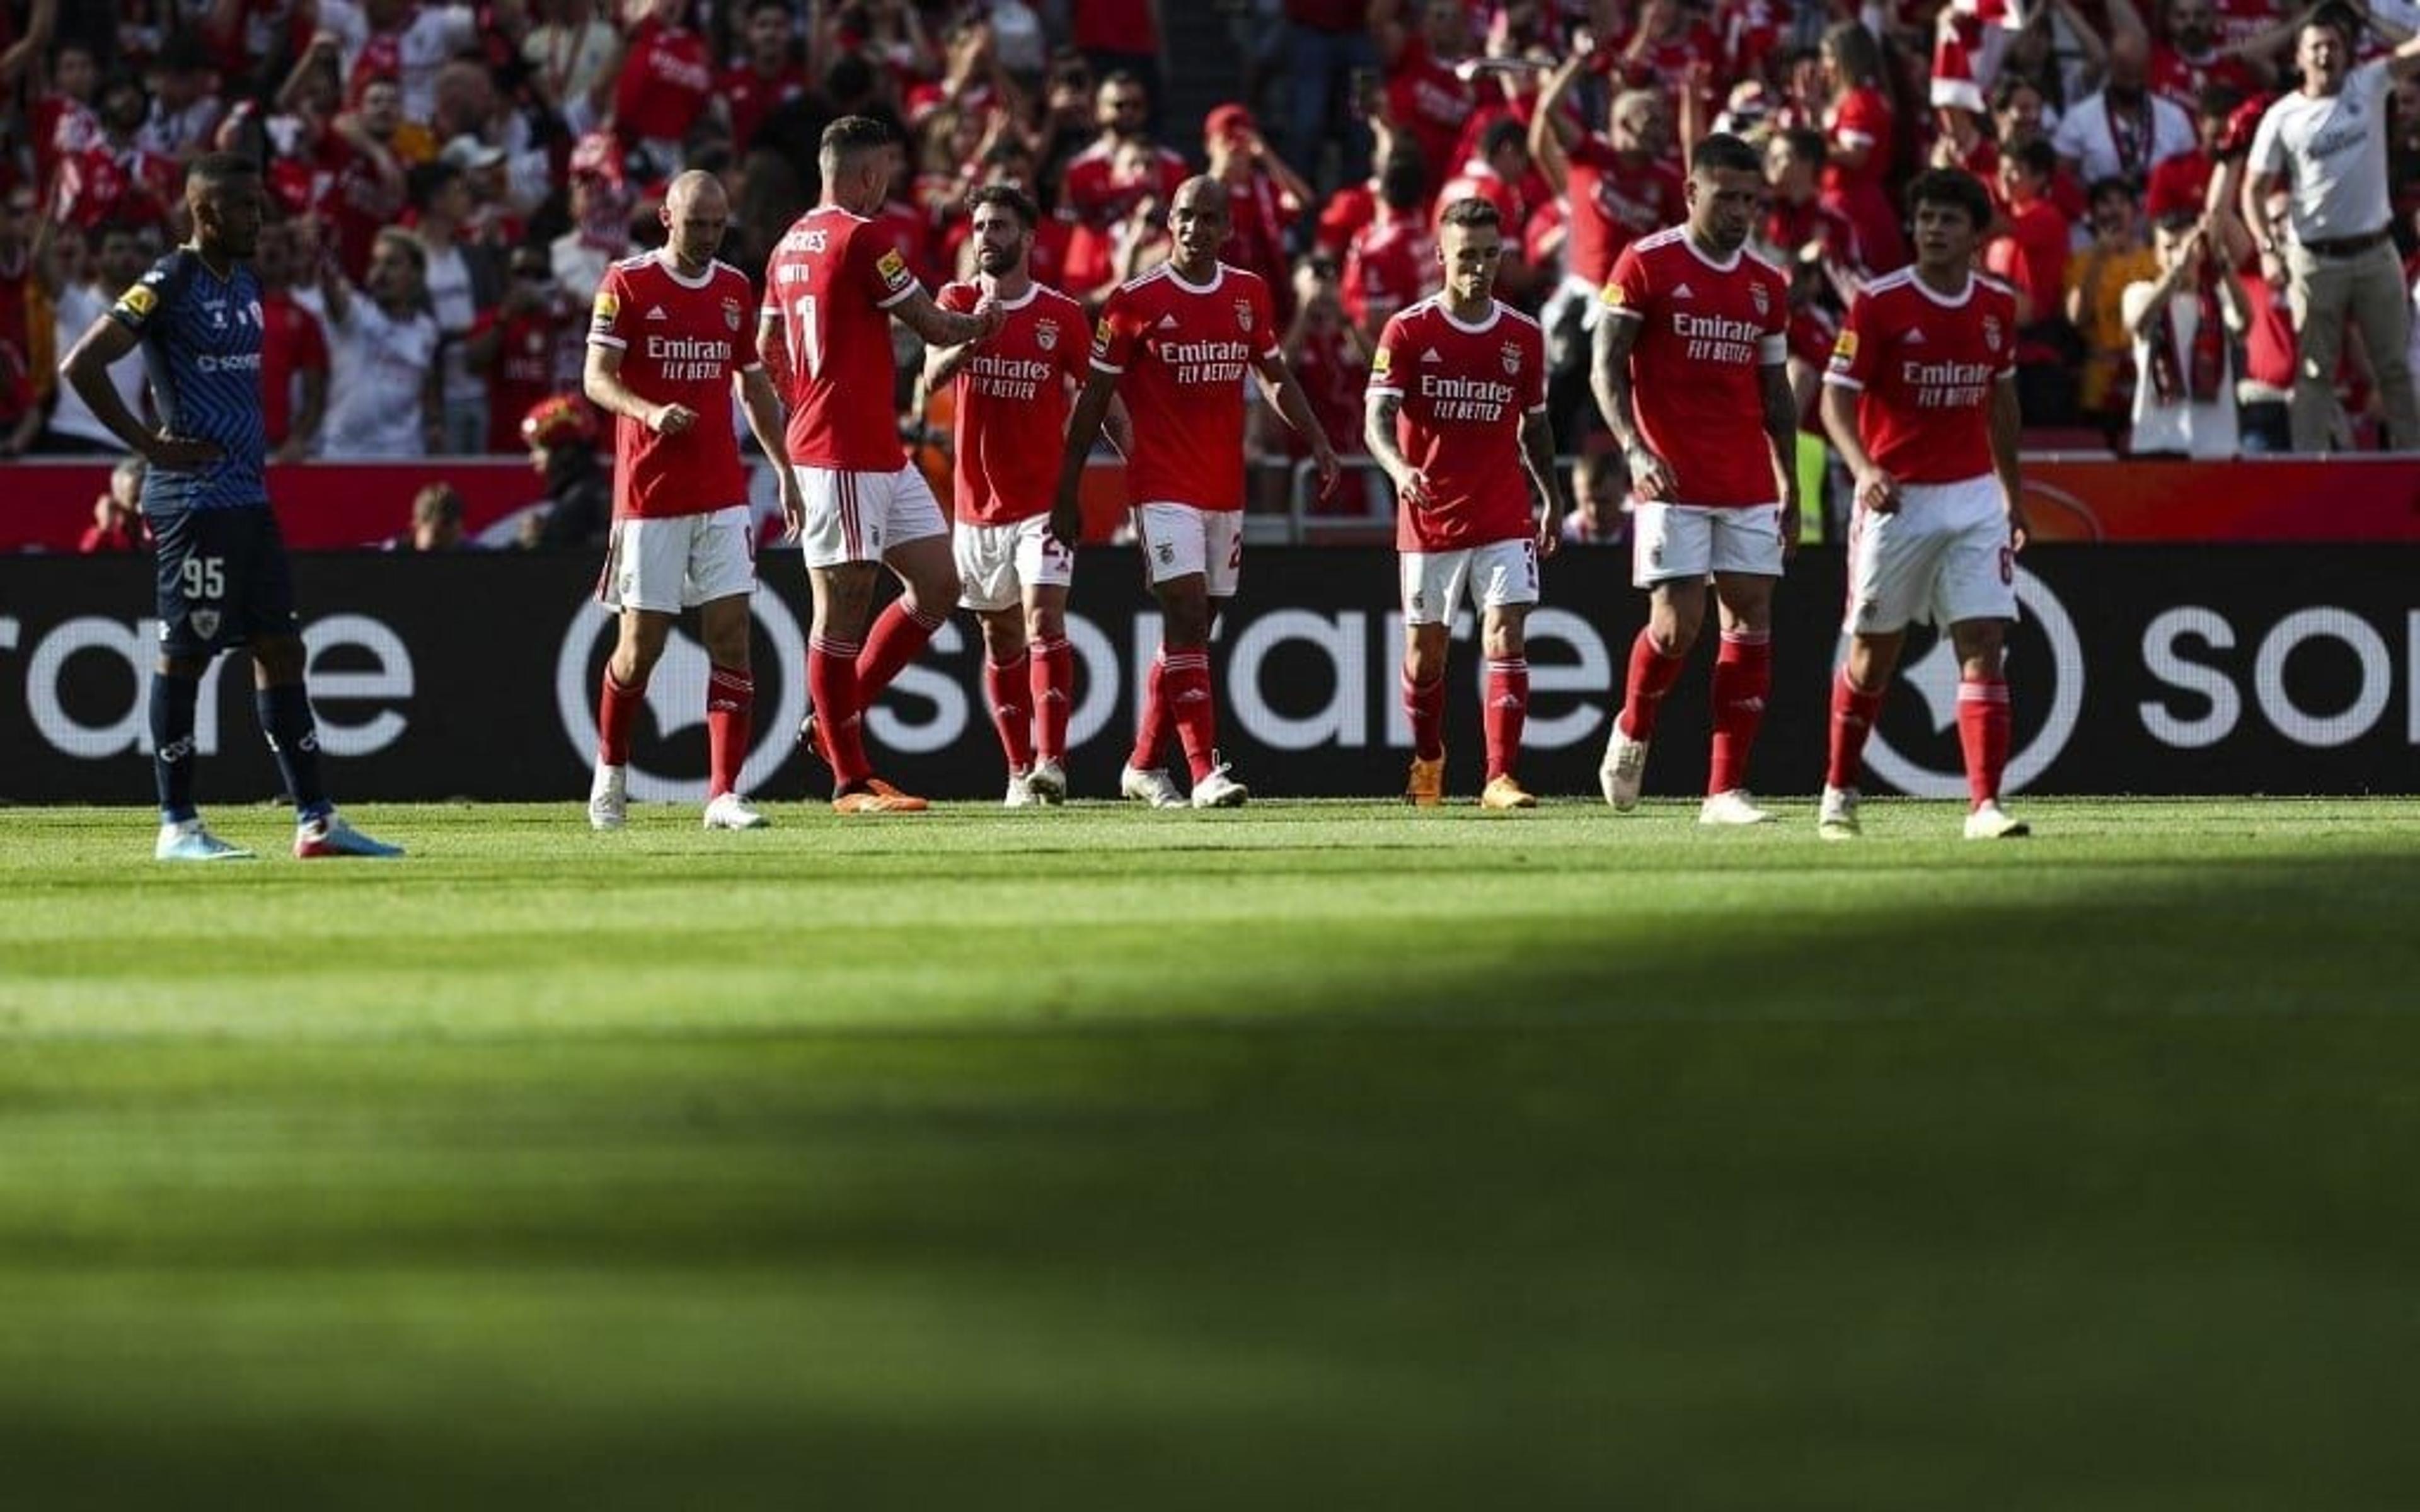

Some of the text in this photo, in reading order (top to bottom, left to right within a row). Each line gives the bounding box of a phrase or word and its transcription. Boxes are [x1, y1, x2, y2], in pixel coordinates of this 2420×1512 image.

[1688, 340, 1712, 360] FLY
[969, 353, 1051, 381] mirates
[1178, 365, 1199, 384] FLY
[1422, 375, 1514, 403] Emirates
[1434, 400, 1502, 422] FLY BETTER
[183, 558, 225, 598] 95
[2139, 605, 2420, 749] so
